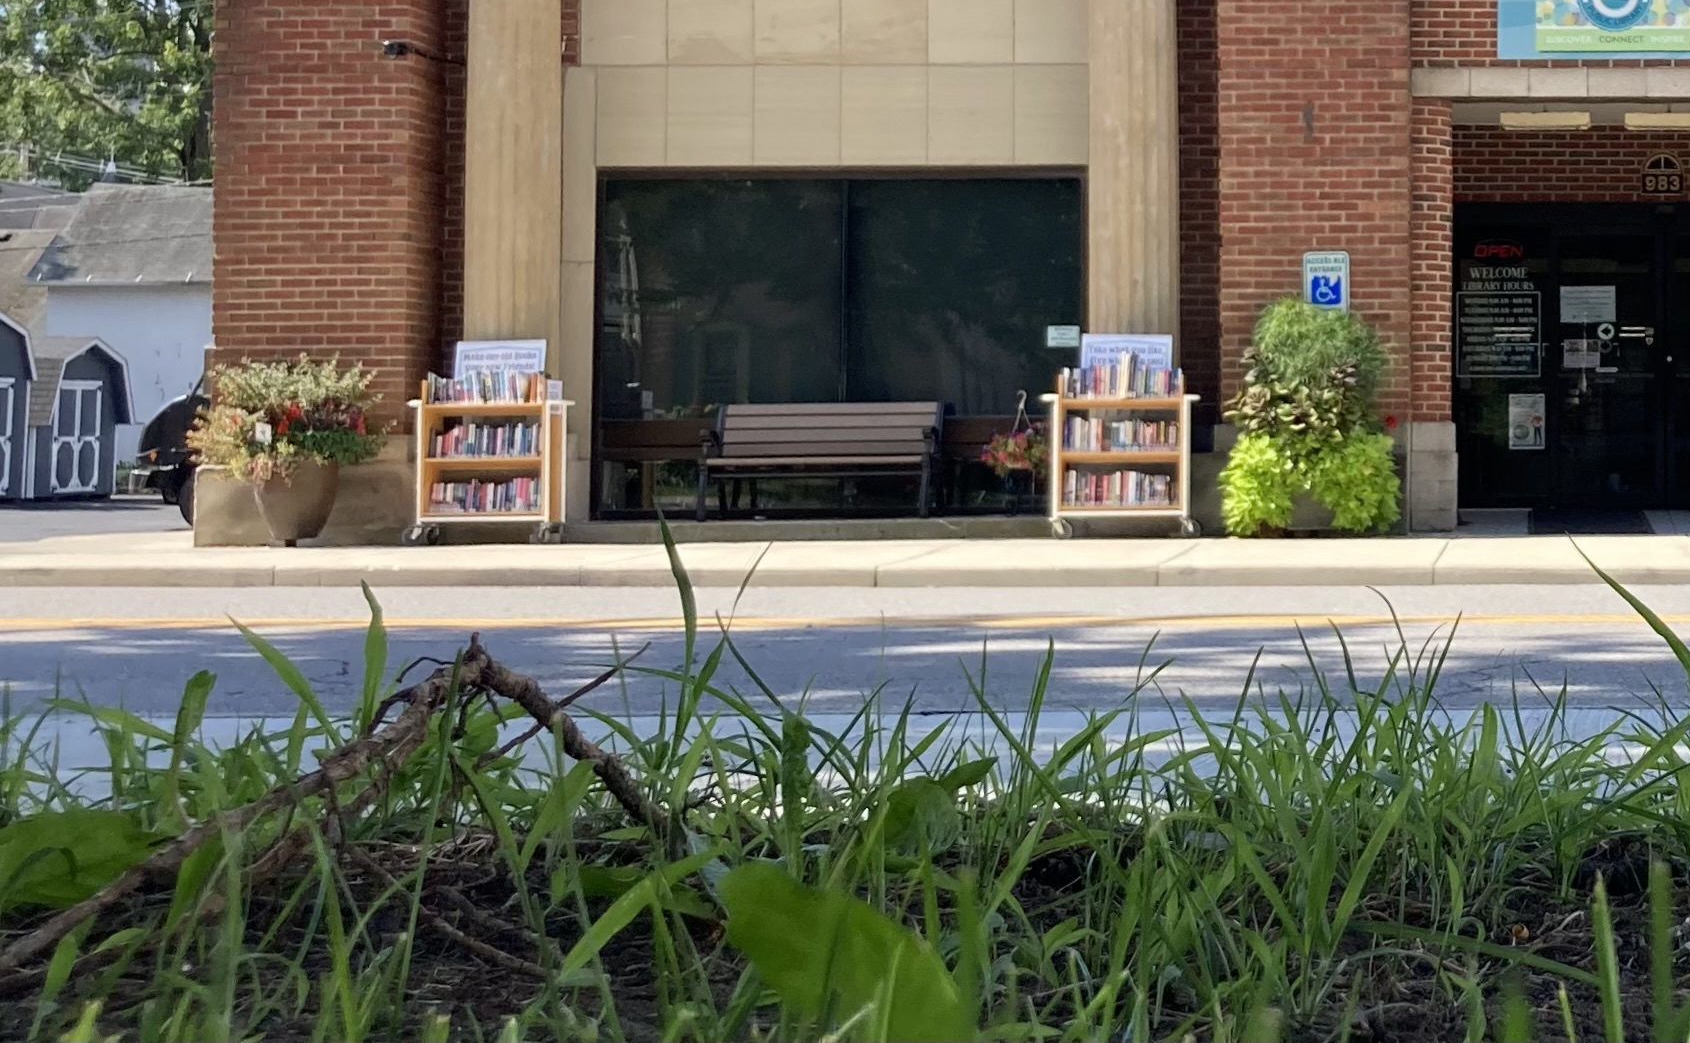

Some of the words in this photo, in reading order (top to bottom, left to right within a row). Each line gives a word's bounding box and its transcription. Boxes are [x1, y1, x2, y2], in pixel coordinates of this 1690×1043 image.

[1546, 35, 1592, 44] DISCOVER
[1599, 35, 1644, 44] CONNECT
[1650, 35, 1686, 44] INSPIRE
[1645, 175, 1680, 191] 983
[1474, 245, 1524, 257] OPEN
[1470, 267, 1528, 278] WELCOME
[1462, 281, 1502, 291] LIBRARY
[1503, 281, 1534, 291] HOURS
